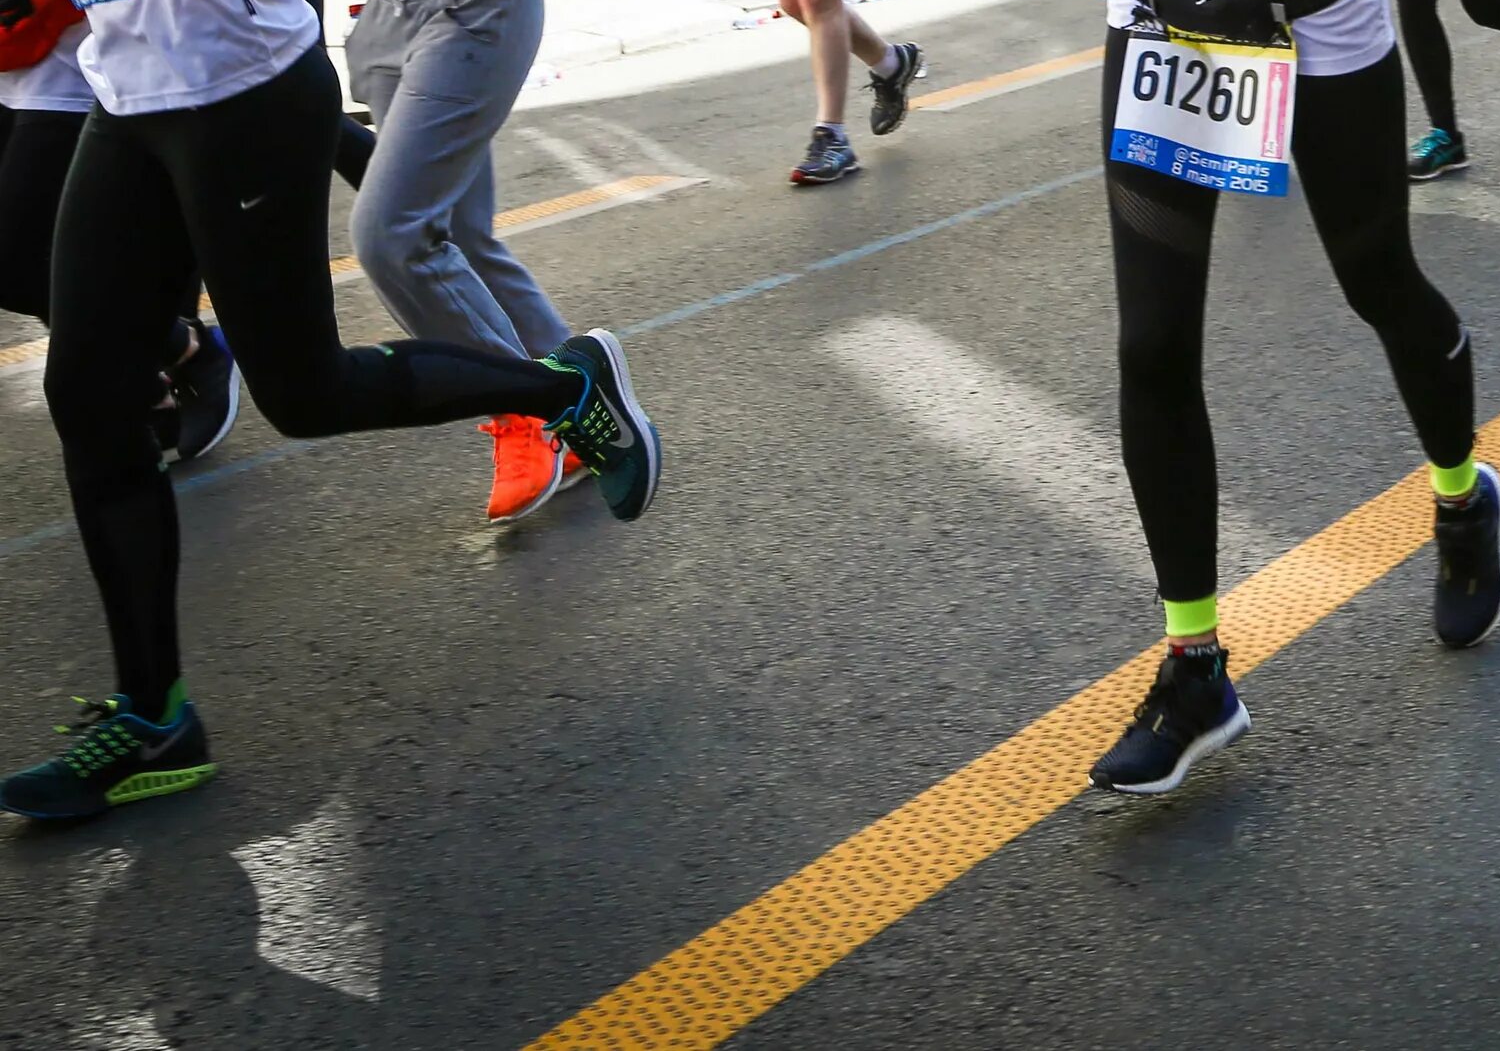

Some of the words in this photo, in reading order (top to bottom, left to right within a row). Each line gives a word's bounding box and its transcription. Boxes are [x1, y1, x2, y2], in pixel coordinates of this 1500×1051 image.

[1132, 50, 1259, 126] 61260
[1171, 162, 1183, 175] 8
[1186, 166, 1226, 188] mars
[1228, 176, 1269, 193] 2015
[1174, 148, 1270, 177] @SemiParis
